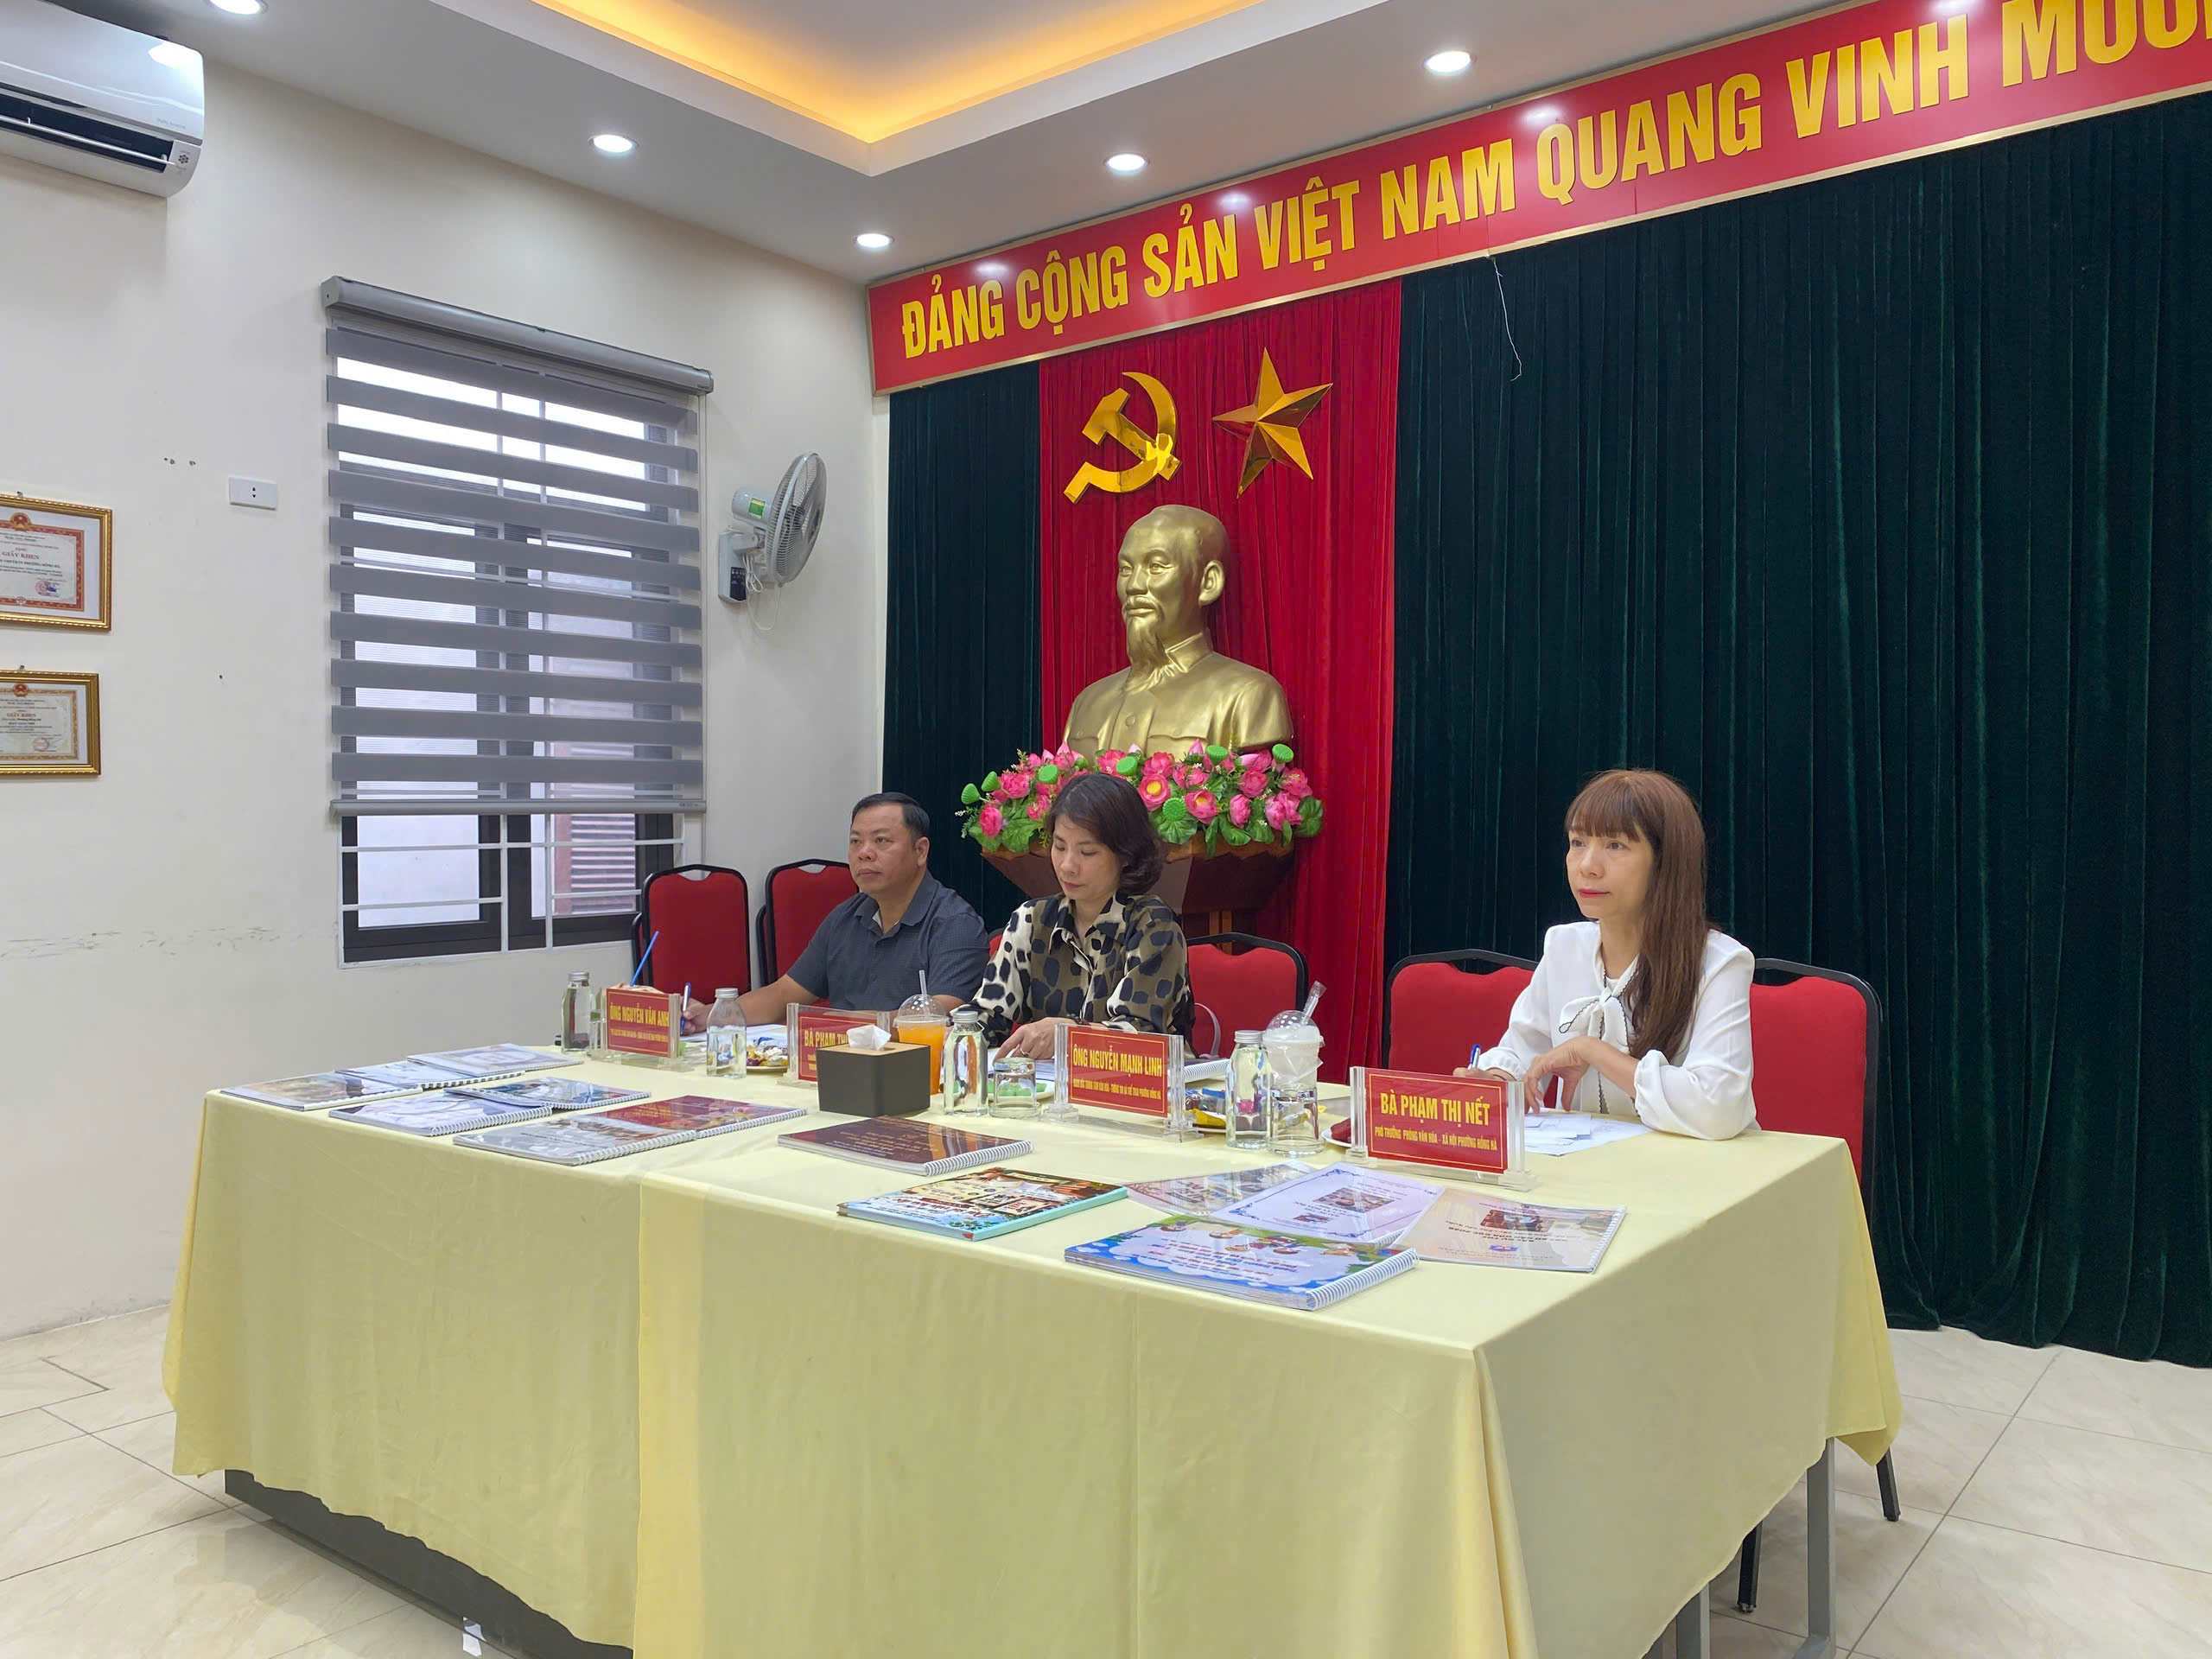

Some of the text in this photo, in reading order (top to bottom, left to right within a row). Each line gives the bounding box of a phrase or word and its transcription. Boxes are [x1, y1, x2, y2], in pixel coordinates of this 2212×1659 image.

[901, 274, 1005, 359] ĐẢNG
[1016, 245, 1128, 335] CỘNG
[1142, 204, 1238, 298] SẢN
[1253, 176, 1360, 271] VIỆT
[1380, 137, 1516, 239] NAM
[1535, 73, 1762, 206] QUANG
[1786, 15, 1968, 138] VINH
[804, 1027, 814, 1047] BÀ
[1072, 1043, 1162, 1077] ÔNG NGUYỄN MẠNH LINH
[1380, 1089, 1491, 1128] BÀ PHẠM THỊ NẾT
